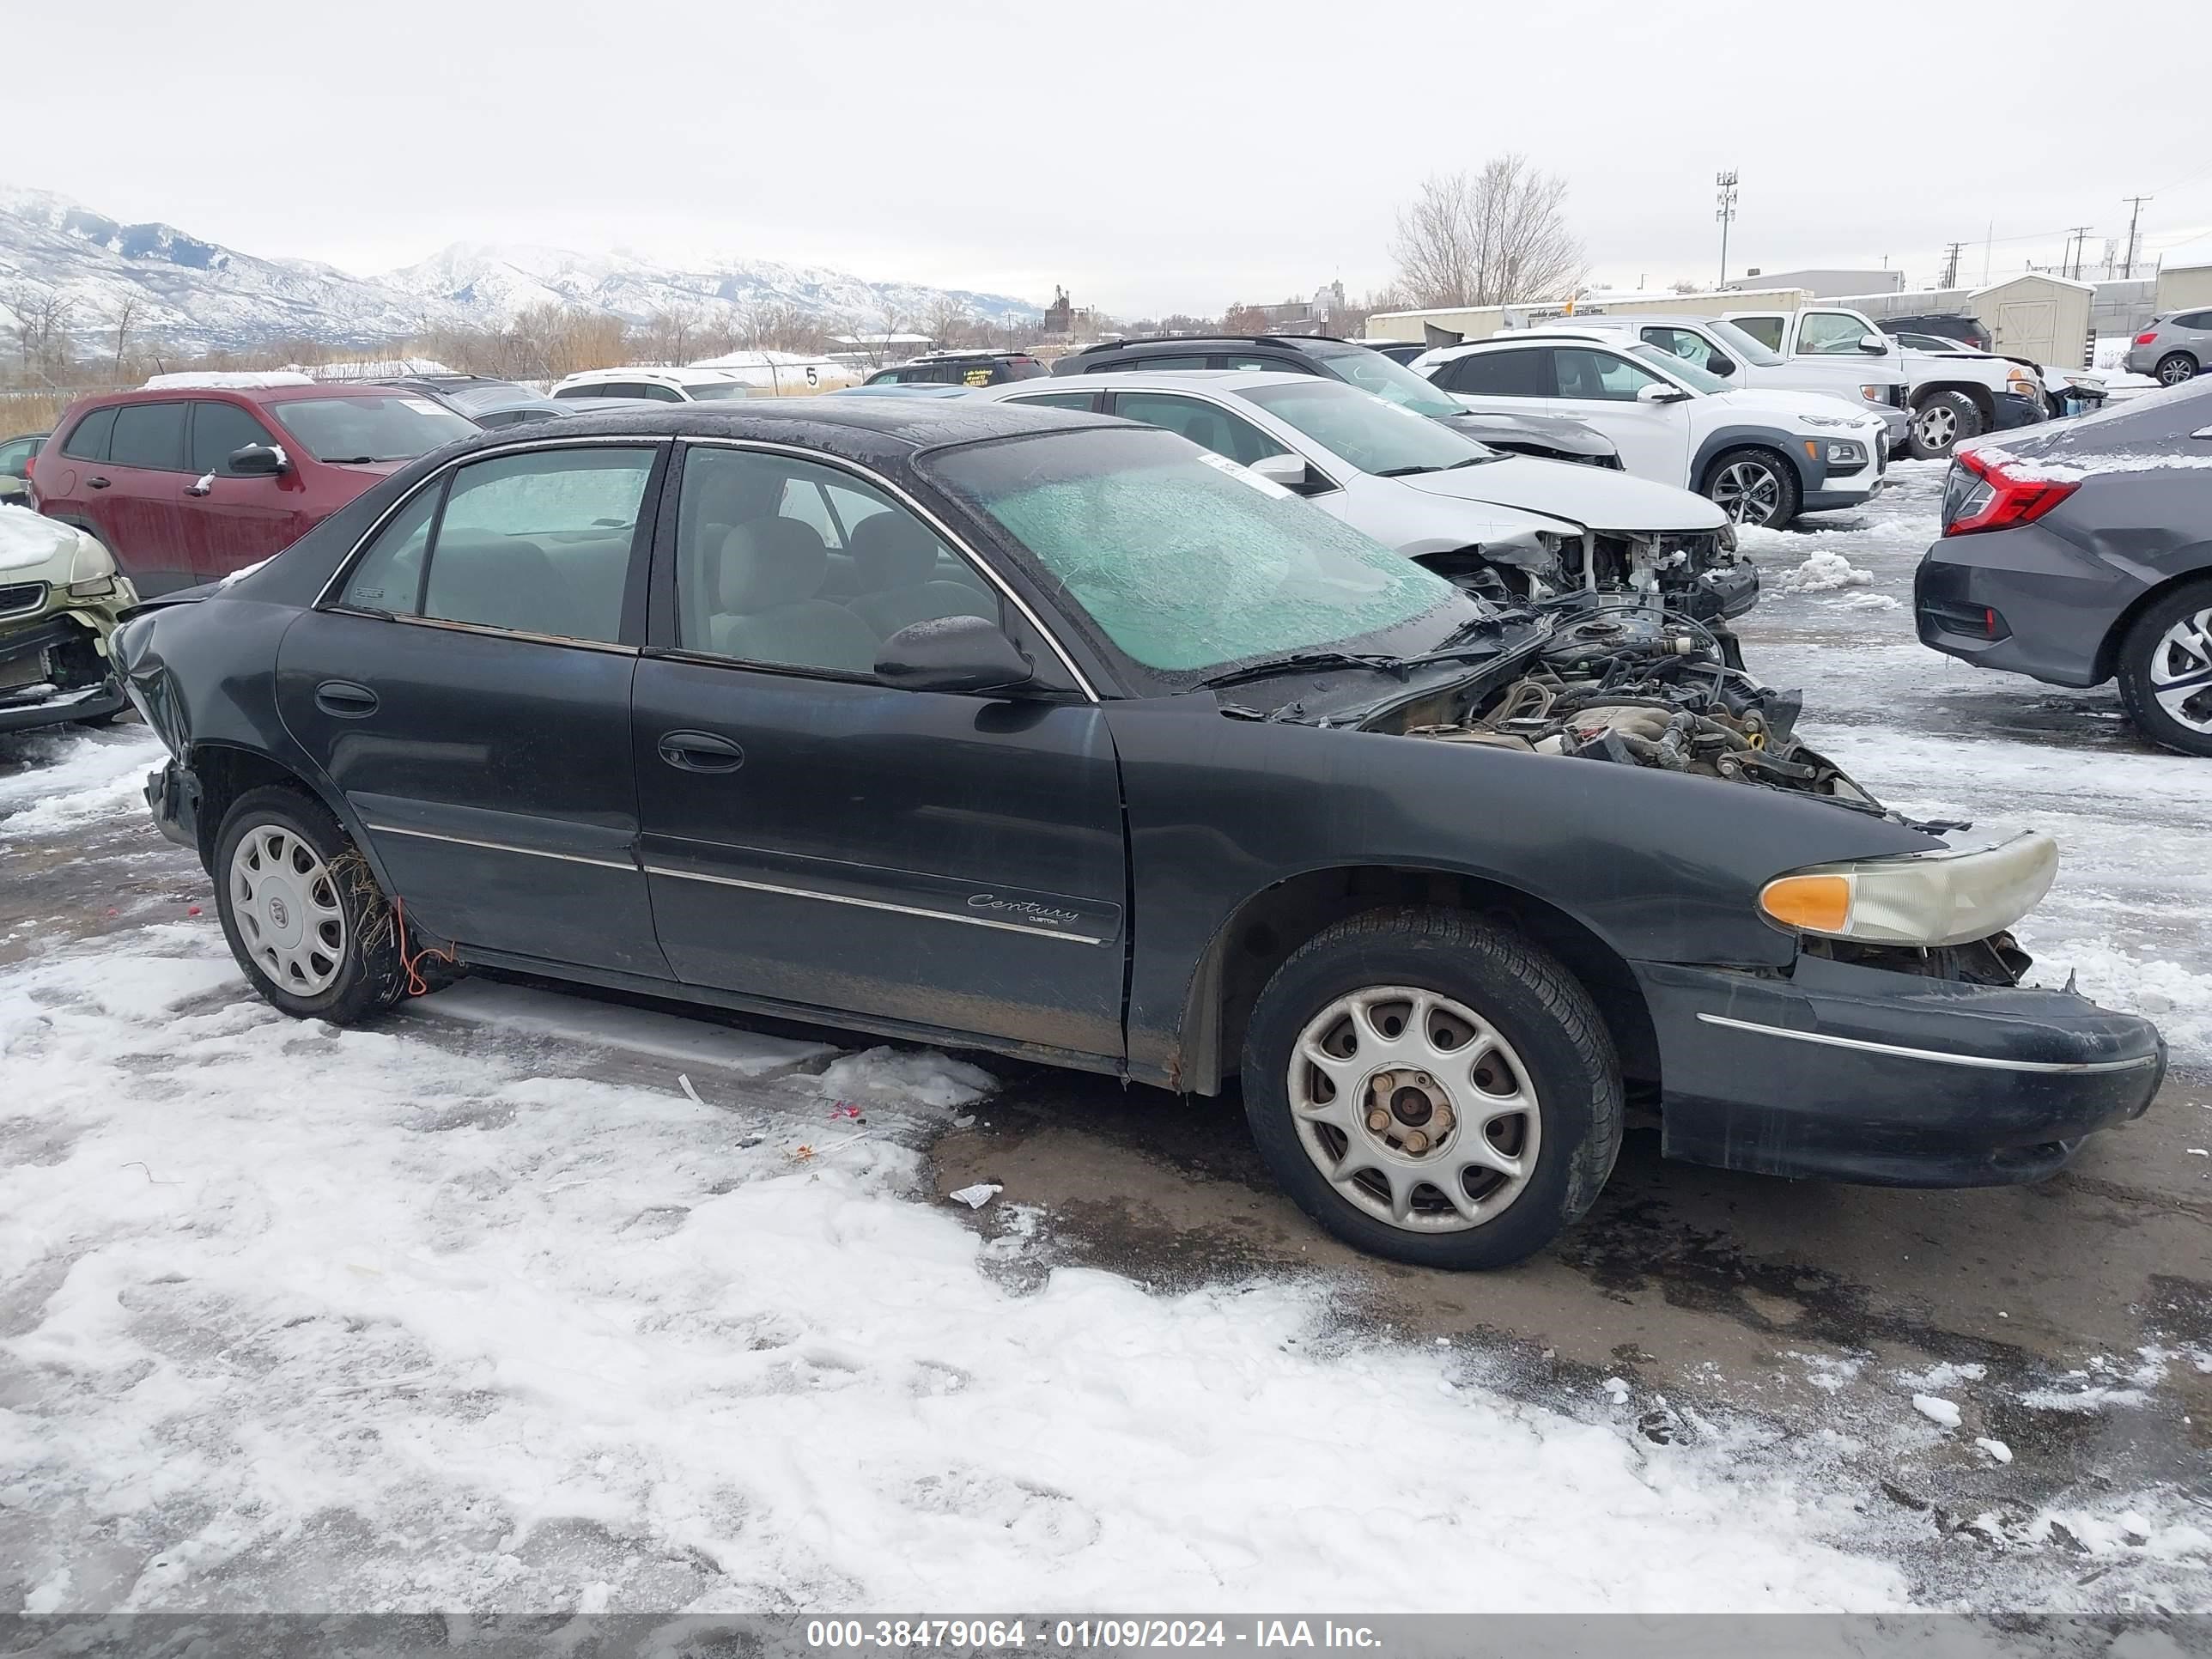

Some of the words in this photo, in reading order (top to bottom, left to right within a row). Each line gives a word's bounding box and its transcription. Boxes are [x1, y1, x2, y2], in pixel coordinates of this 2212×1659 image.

[806, 367, 817, 386] 5
[967, 894, 1079, 922] Century
[1028, 915, 1059, 925] CUSTOM
